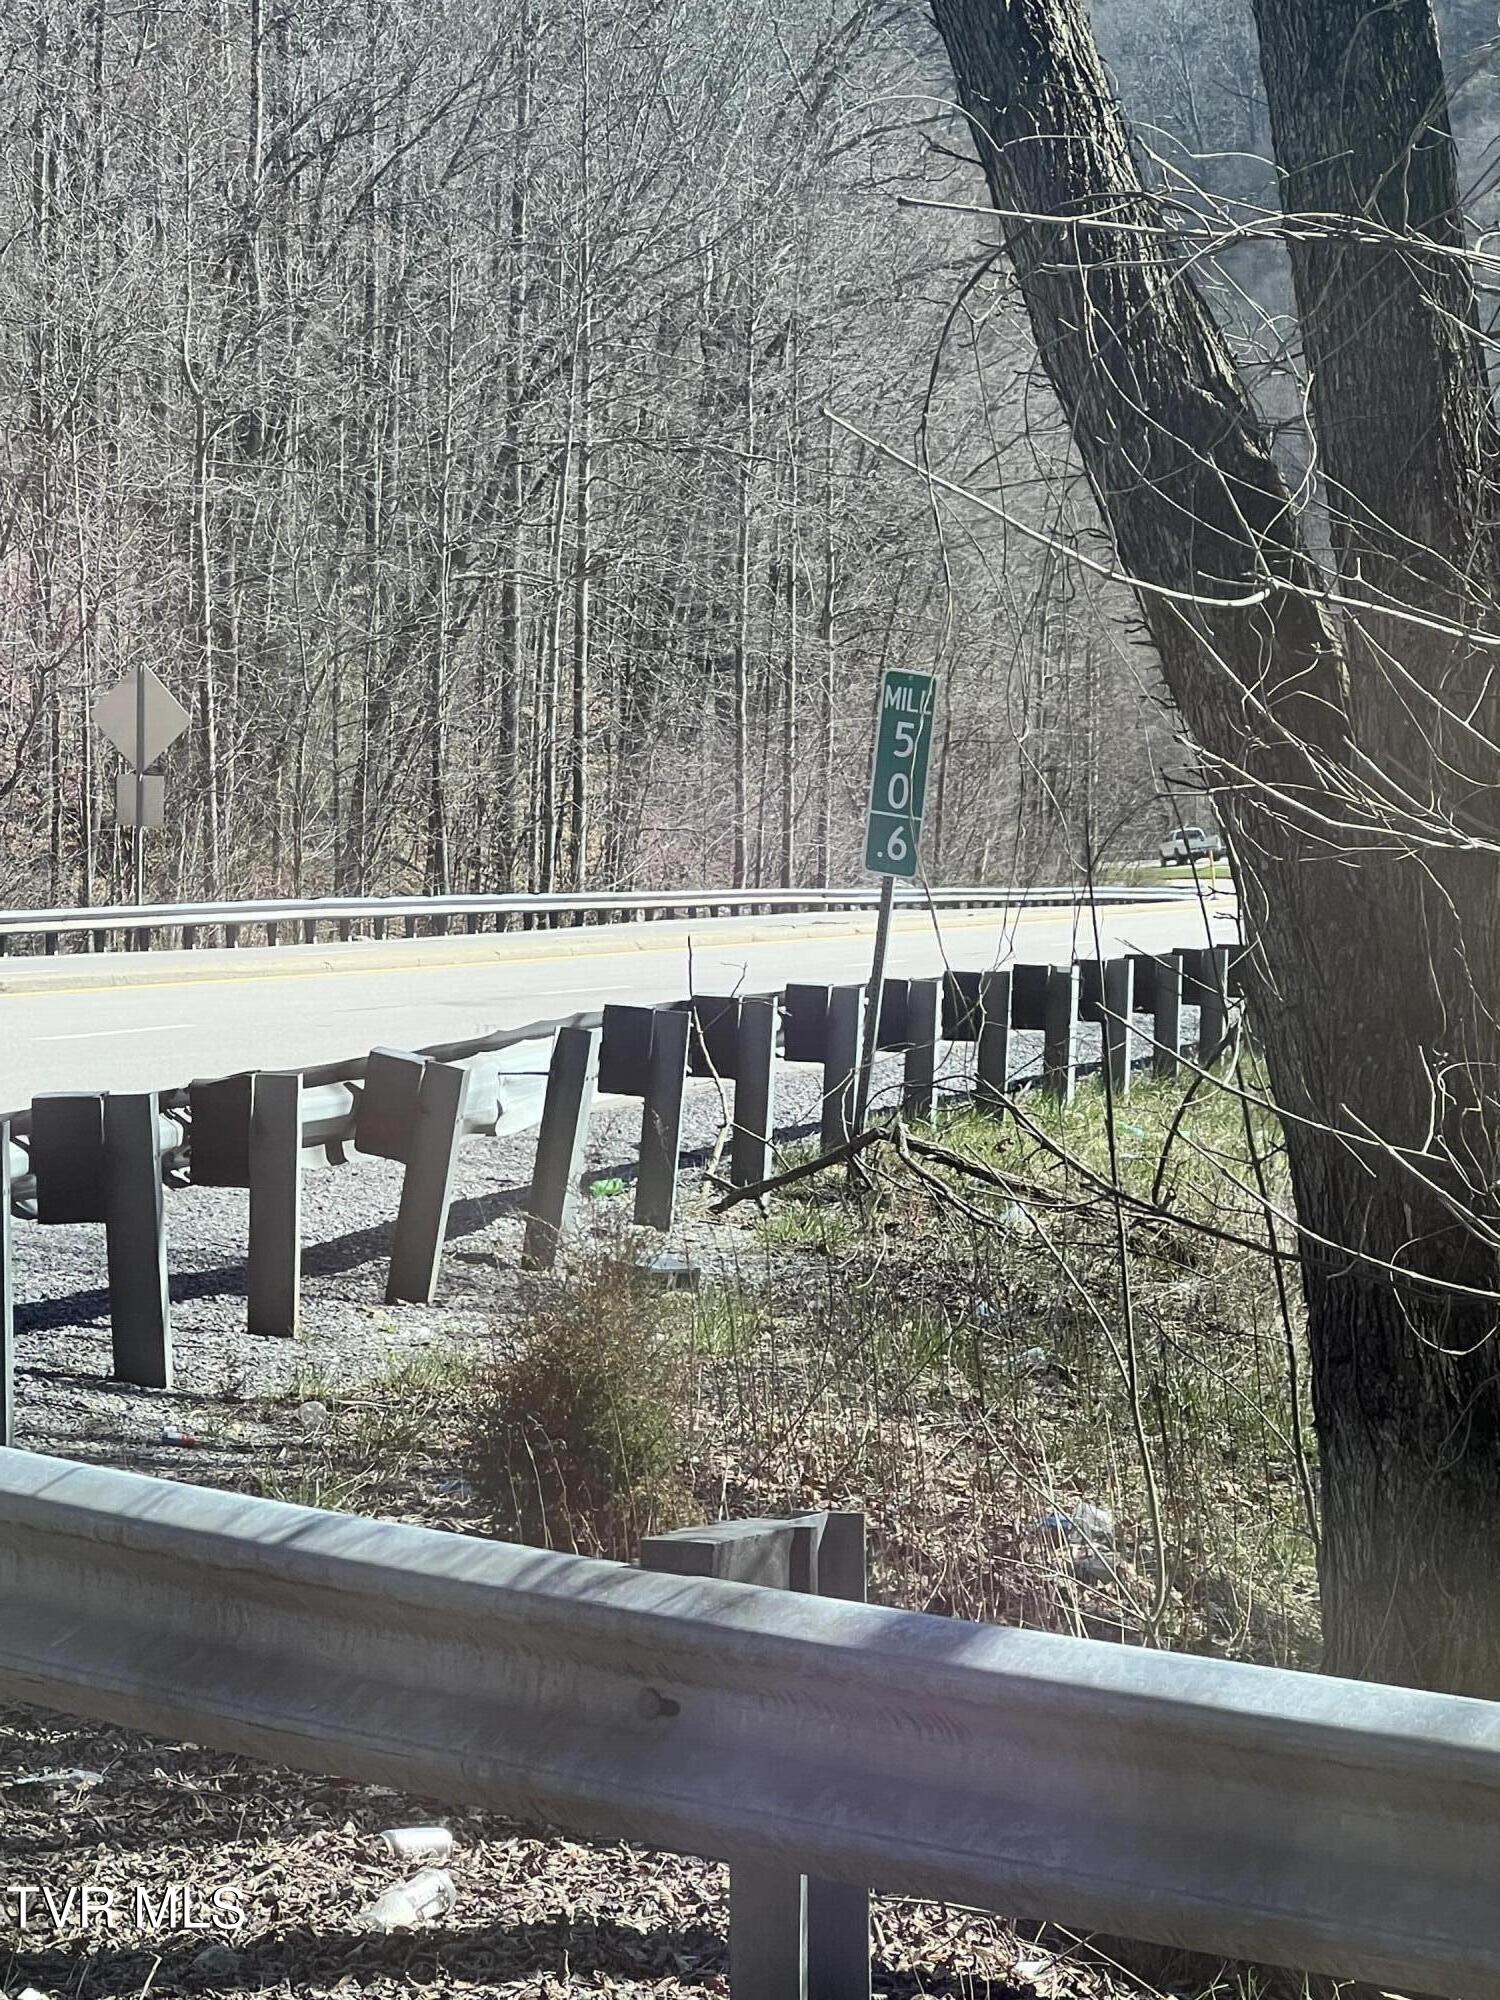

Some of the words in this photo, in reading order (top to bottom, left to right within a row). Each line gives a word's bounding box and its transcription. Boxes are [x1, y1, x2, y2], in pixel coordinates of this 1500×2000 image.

[893, 721, 915, 758] 5
[887, 772, 909, 809] 0
[877, 826, 907, 861] .6
